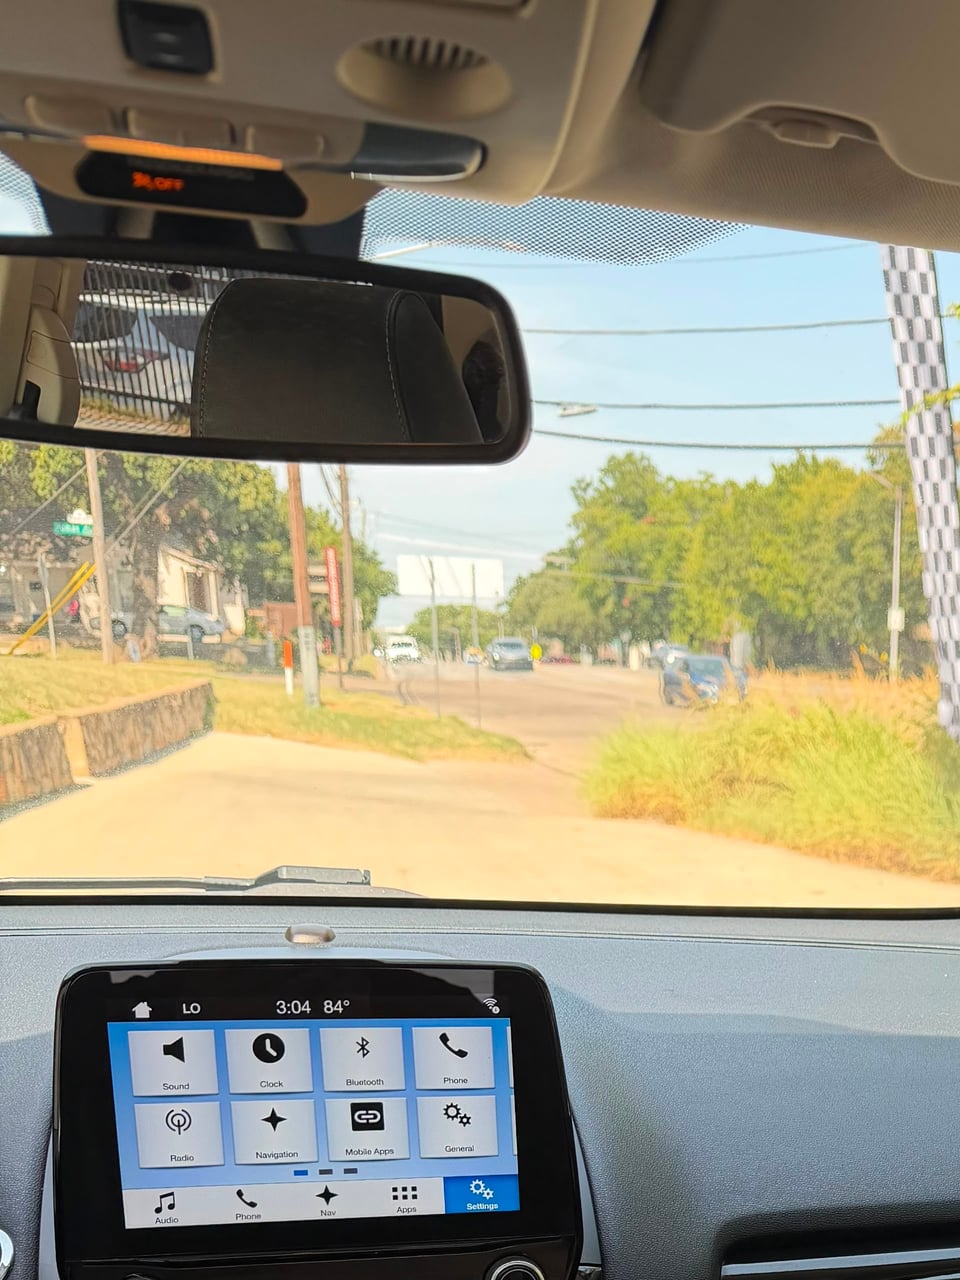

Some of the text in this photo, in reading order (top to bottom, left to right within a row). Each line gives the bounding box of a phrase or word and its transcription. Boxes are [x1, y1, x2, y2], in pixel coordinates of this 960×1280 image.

[182, 1002, 201, 1015] LO
[276, 1000, 350, 1015] 3:04 84°
[260, 1080, 284, 1089] Clock
[345, 1078, 384, 1087] Bluetooth
[443, 1077, 469, 1085] Phone
[163, 1082, 190, 1091] Sound
[345, 1147, 395, 1157] Mobile Apps
[445, 1144, 475, 1153] General
[170, 1153, 195, 1162] Radio
[255, 1150, 299, 1161] Navigation
[396, 1206, 417, 1214] Apps
[466, 1202, 499, 1212] Settings
[235, 1213, 262, 1222] Phone
[320, 1209, 337, 1217] Nav
[155, 1216, 179, 1225] Audio
